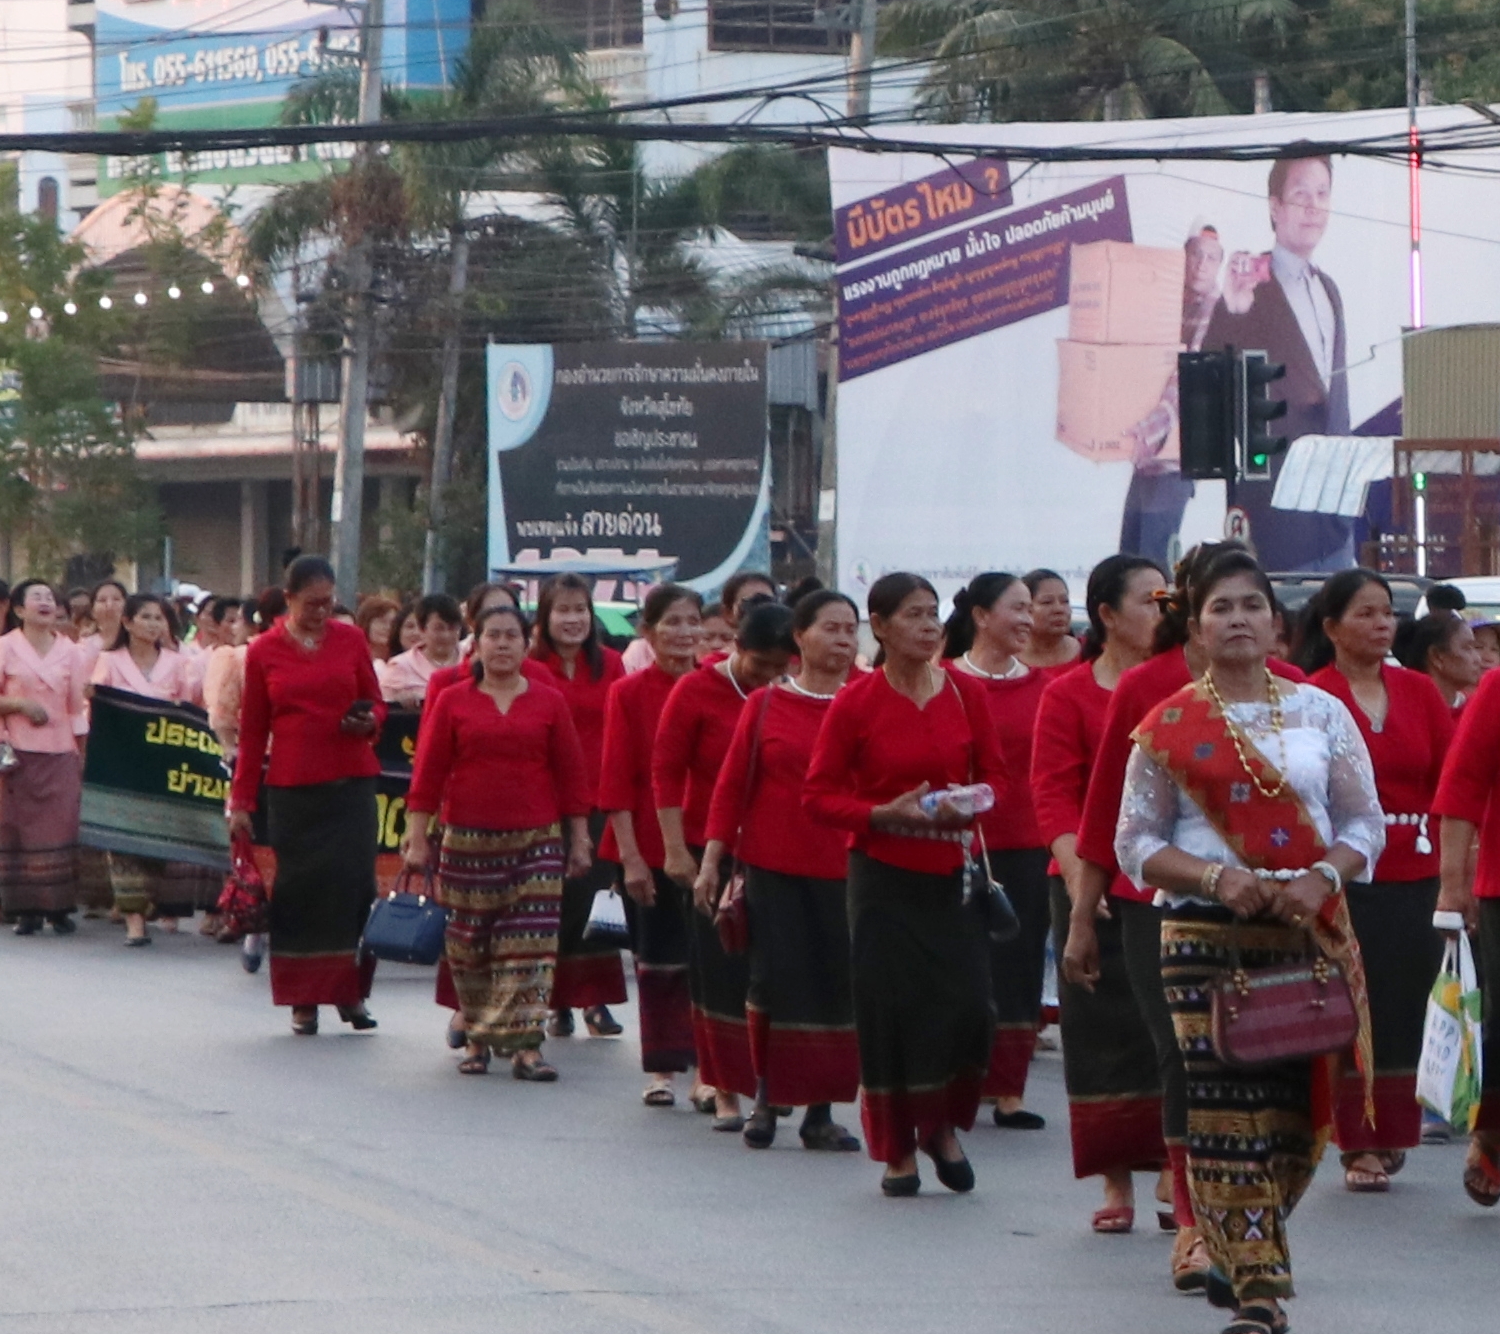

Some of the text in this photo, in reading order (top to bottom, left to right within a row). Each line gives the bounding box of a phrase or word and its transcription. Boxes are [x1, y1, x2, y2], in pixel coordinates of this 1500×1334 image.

[966, 231, 1001, 259] มั่นใจ
[581, 503, 663, 538] สายด่วน
